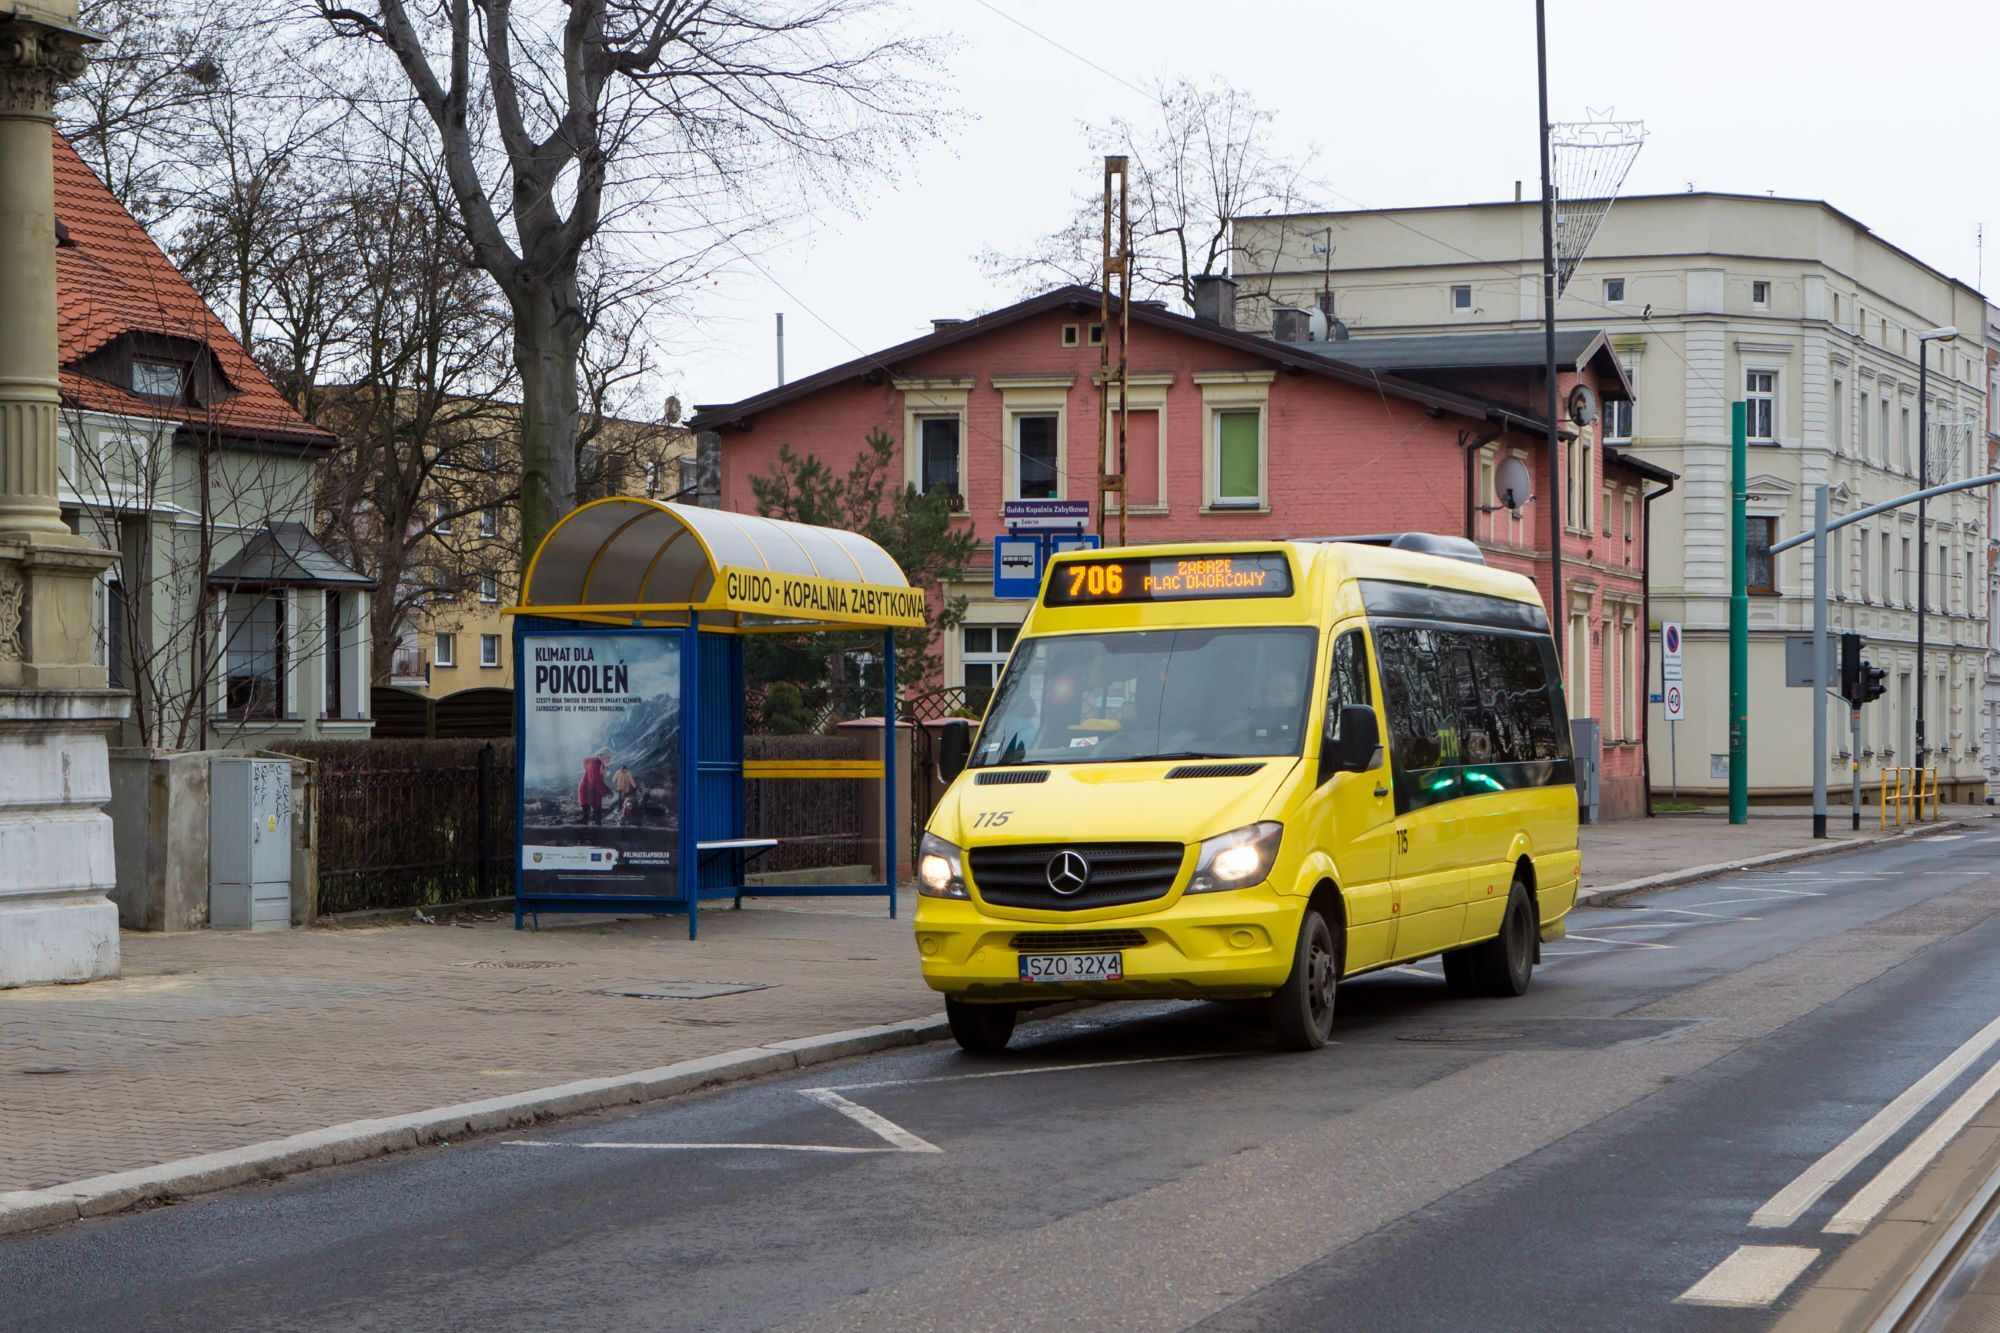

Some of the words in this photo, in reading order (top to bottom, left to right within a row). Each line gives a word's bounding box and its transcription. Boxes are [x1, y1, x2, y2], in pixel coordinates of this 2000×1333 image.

[1026, 506, 1053, 514] Kopalnia
[1054, 505, 1088, 514] Zabytkowa
[1178, 559, 1231, 576] ZABRZE
[1069, 564, 1122, 596] 706
[1144, 575, 1181, 591] PLAC
[1186, 571, 1266, 589] DWORCOWY
[727, 572, 772, 603] GUIDO
[783, 580, 848, 613] KOPALNIA
[851, 588, 925, 618] ZABYTKOWA
[535, 647, 571, 661] KLIMAT
[574, 647, 594, 661] DLA
[535, 659, 629, 694] POKOLEŃ
[1670, 694, 1679, 706] 40
[973, 811, 1014, 829] 115
[1396, 829, 1409, 856] 115
[1030, 957, 1067, 976] SZO
[1074, 955, 1119, 975] 32X4
